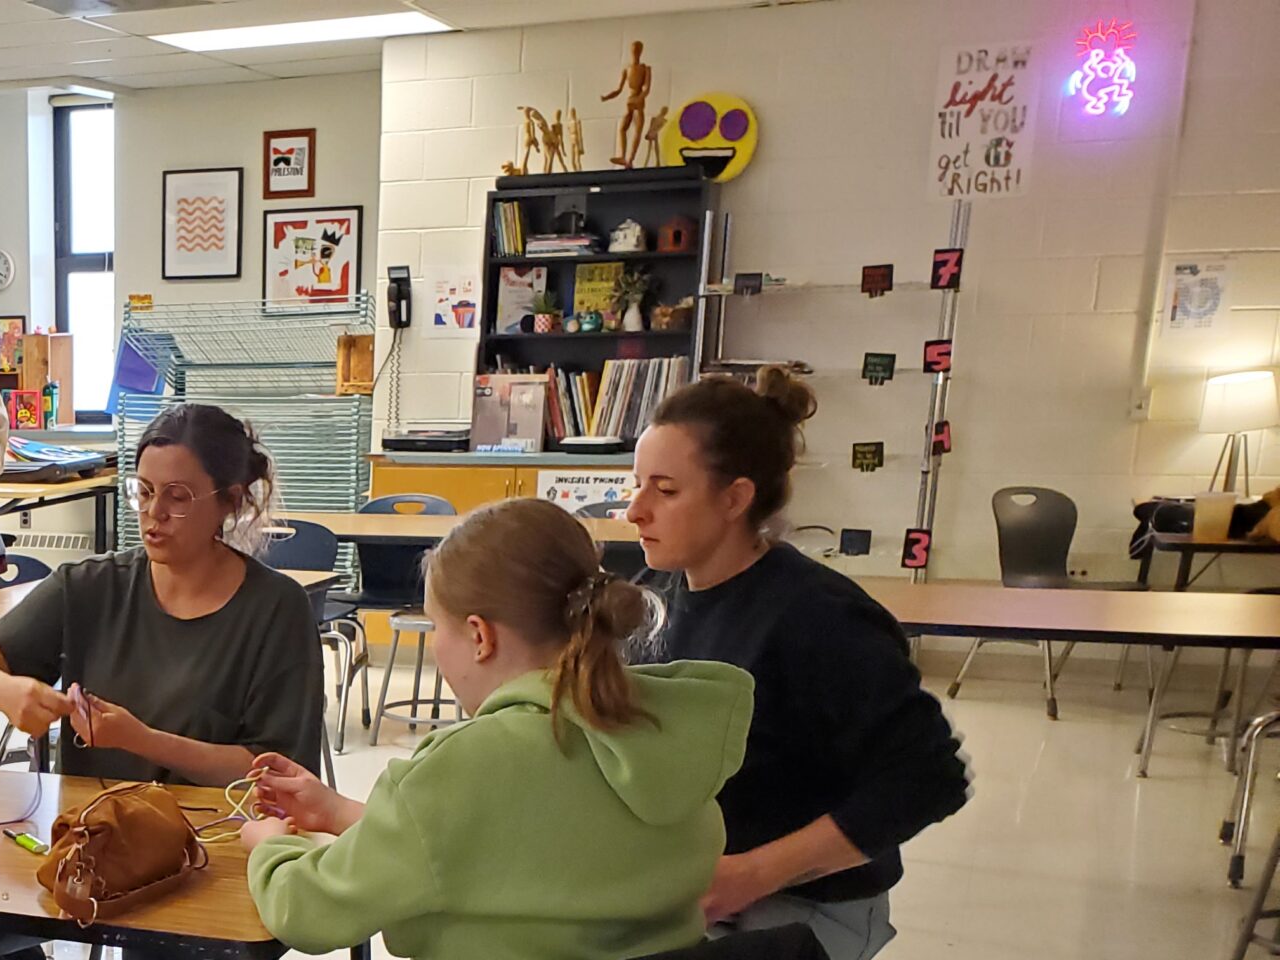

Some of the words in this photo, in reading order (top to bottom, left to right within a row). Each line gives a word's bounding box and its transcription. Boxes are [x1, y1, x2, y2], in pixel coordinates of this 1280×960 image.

[955, 47, 1031, 75] DRAW
[943, 73, 1016, 118] light
[979, 105, 1028, 135] YOU
[937, 142, 970, 182] get
[934, 251, 961, 287] 7
[925, 343, 952, 371] 5
[593, 476, 627, 484] THINGS
[904, 532, 930, 567] 3
